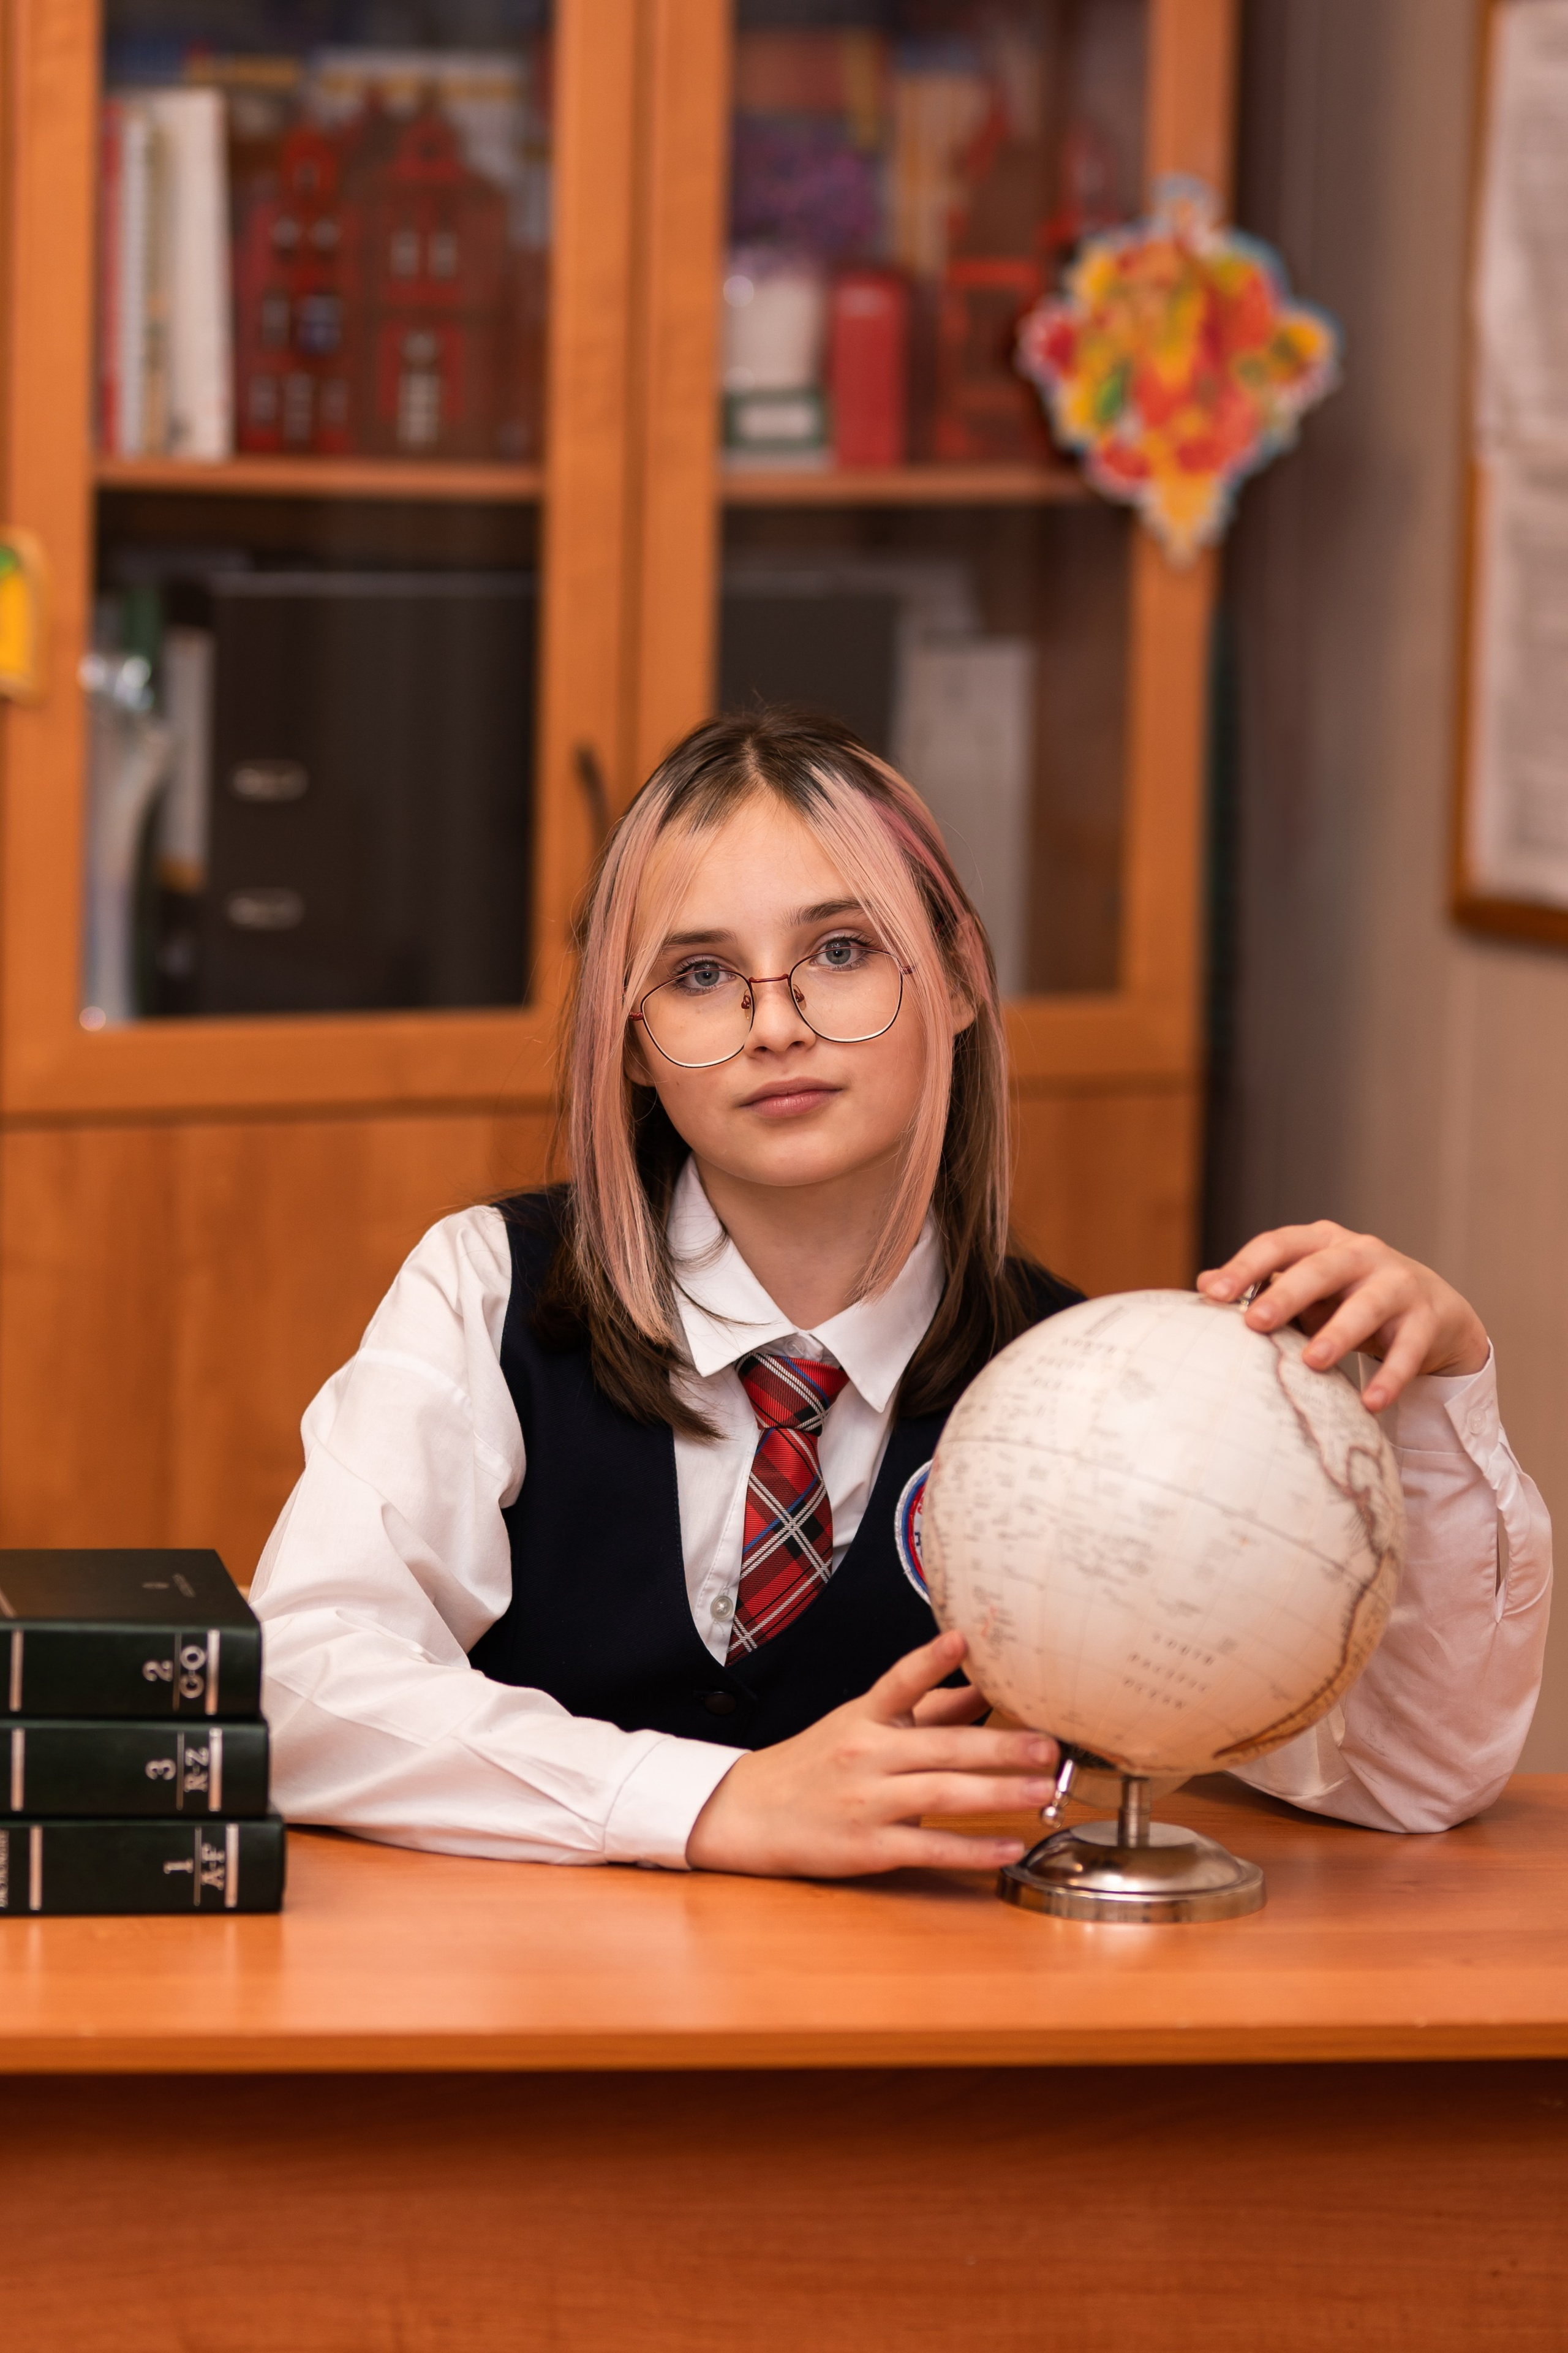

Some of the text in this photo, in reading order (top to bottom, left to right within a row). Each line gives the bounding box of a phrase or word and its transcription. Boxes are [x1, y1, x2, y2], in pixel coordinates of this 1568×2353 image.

[142, 1660, 173, 1682] 2
[145, 1758, 176, 1781] 3
[163, 1858, 194, 1874] 1
